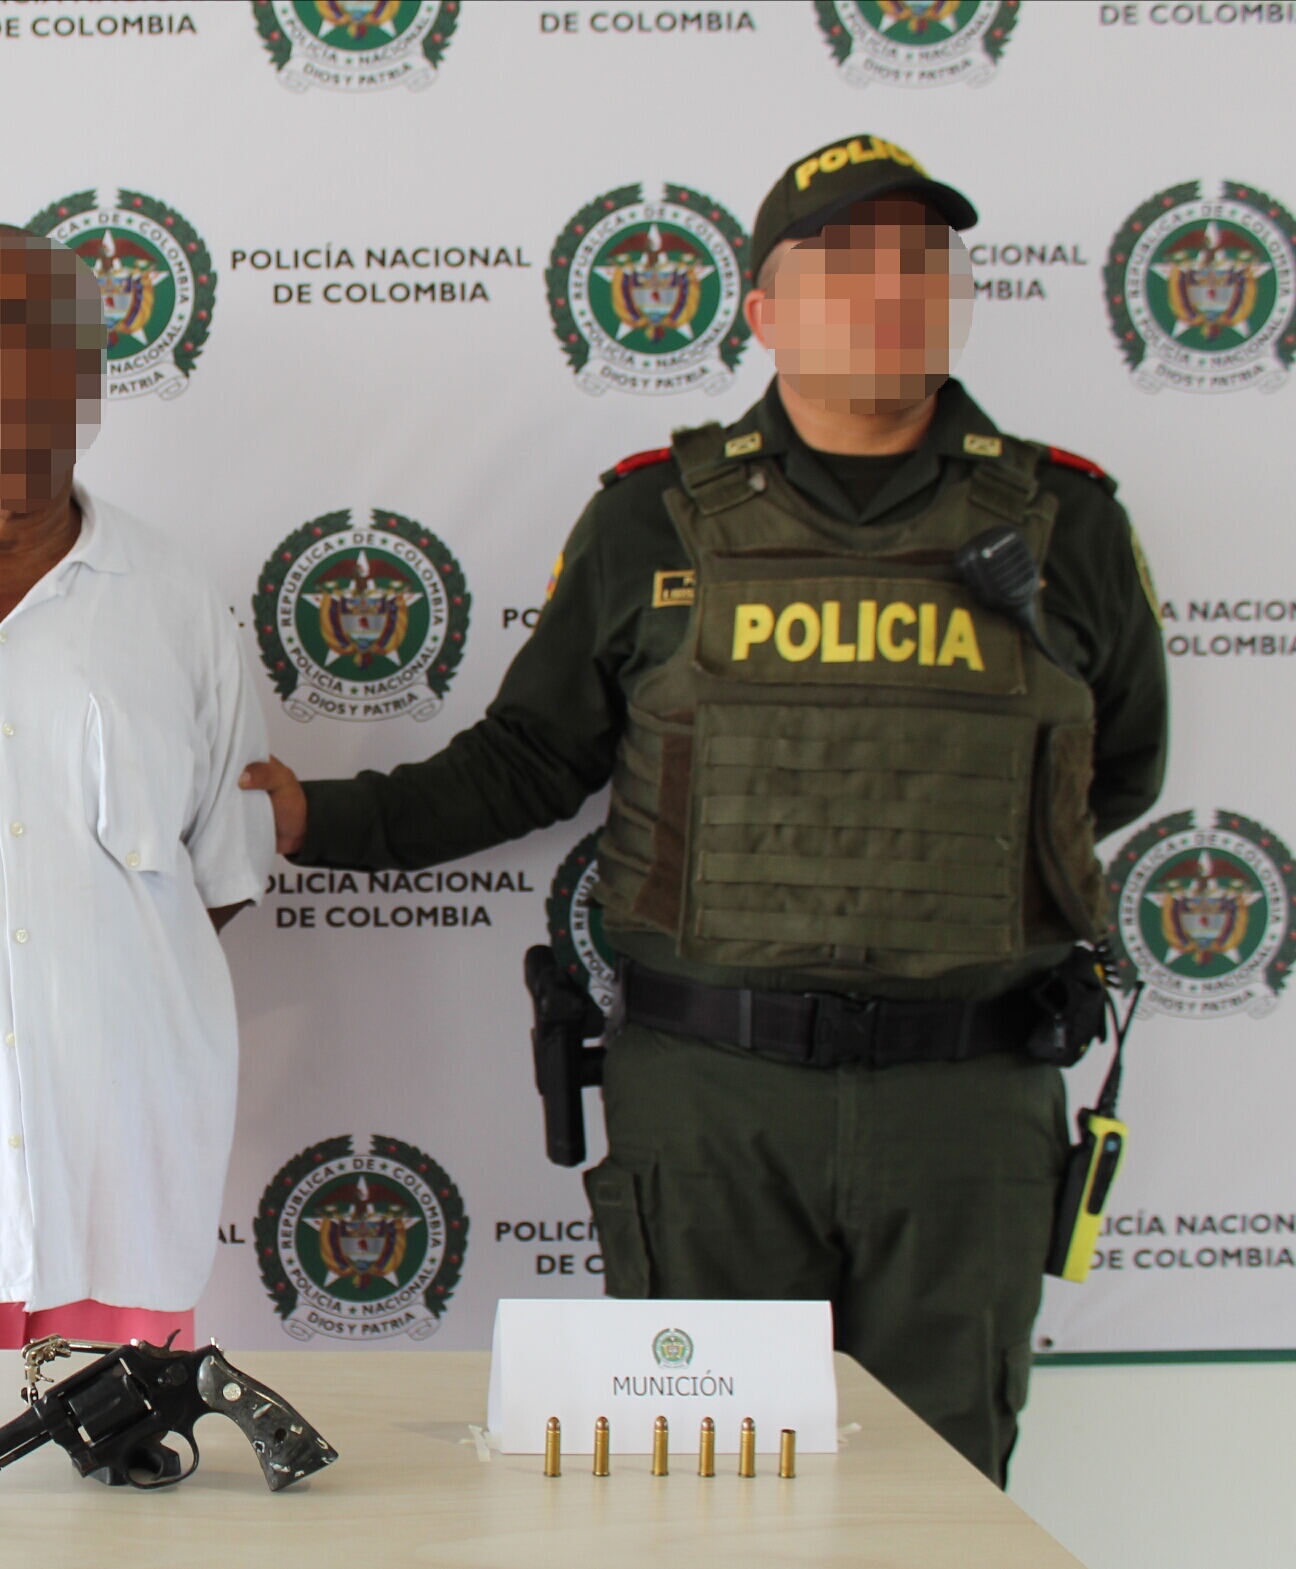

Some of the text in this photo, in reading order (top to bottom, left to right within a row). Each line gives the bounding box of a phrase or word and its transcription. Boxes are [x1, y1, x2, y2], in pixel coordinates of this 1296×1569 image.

[31, 14, 196, 37] COLOMBIA
[540, 11, 757, 34] DE COLOMBIA
[1100, 3, 1296, 26] DE COLOMBI
[100, 214, 189, 304] DE COLOMBIA
[231, 242, 532, 270] POLICÍA NACIONAL
[970, 246, 1087, 267] CIONAL
[273, 282, 489, 304] DE COLOMBIA
[110, 325, 182, 373] NACIONAL
[110, 372, 164, 394] PATRIA
[354, 534, 374, 544] DE
[394, 542, 443, 626] COLOMBIA
[731, 600, 985, 672] POLICIA
[364, 646, 437, 695] NACIONAL
[364, 693, 418, 715] PATRIA
[367, 871, 535, 894] NACIONAL
[276, 905, 492, 929] DE COLOMBIA
[354, 1160, 374, 1169] DE
[393, 1168, 441, 1248] COLOMBIA
[1176, 1213, 1296, 1235] NACION
[536, 1255, 575, 1276] DE
[362, 1268, 434, 1314] NACIONAL
[362, 1313, 415, 1334] PATRIA
[612, 1369, 735, 1397] MUNICIÓN
